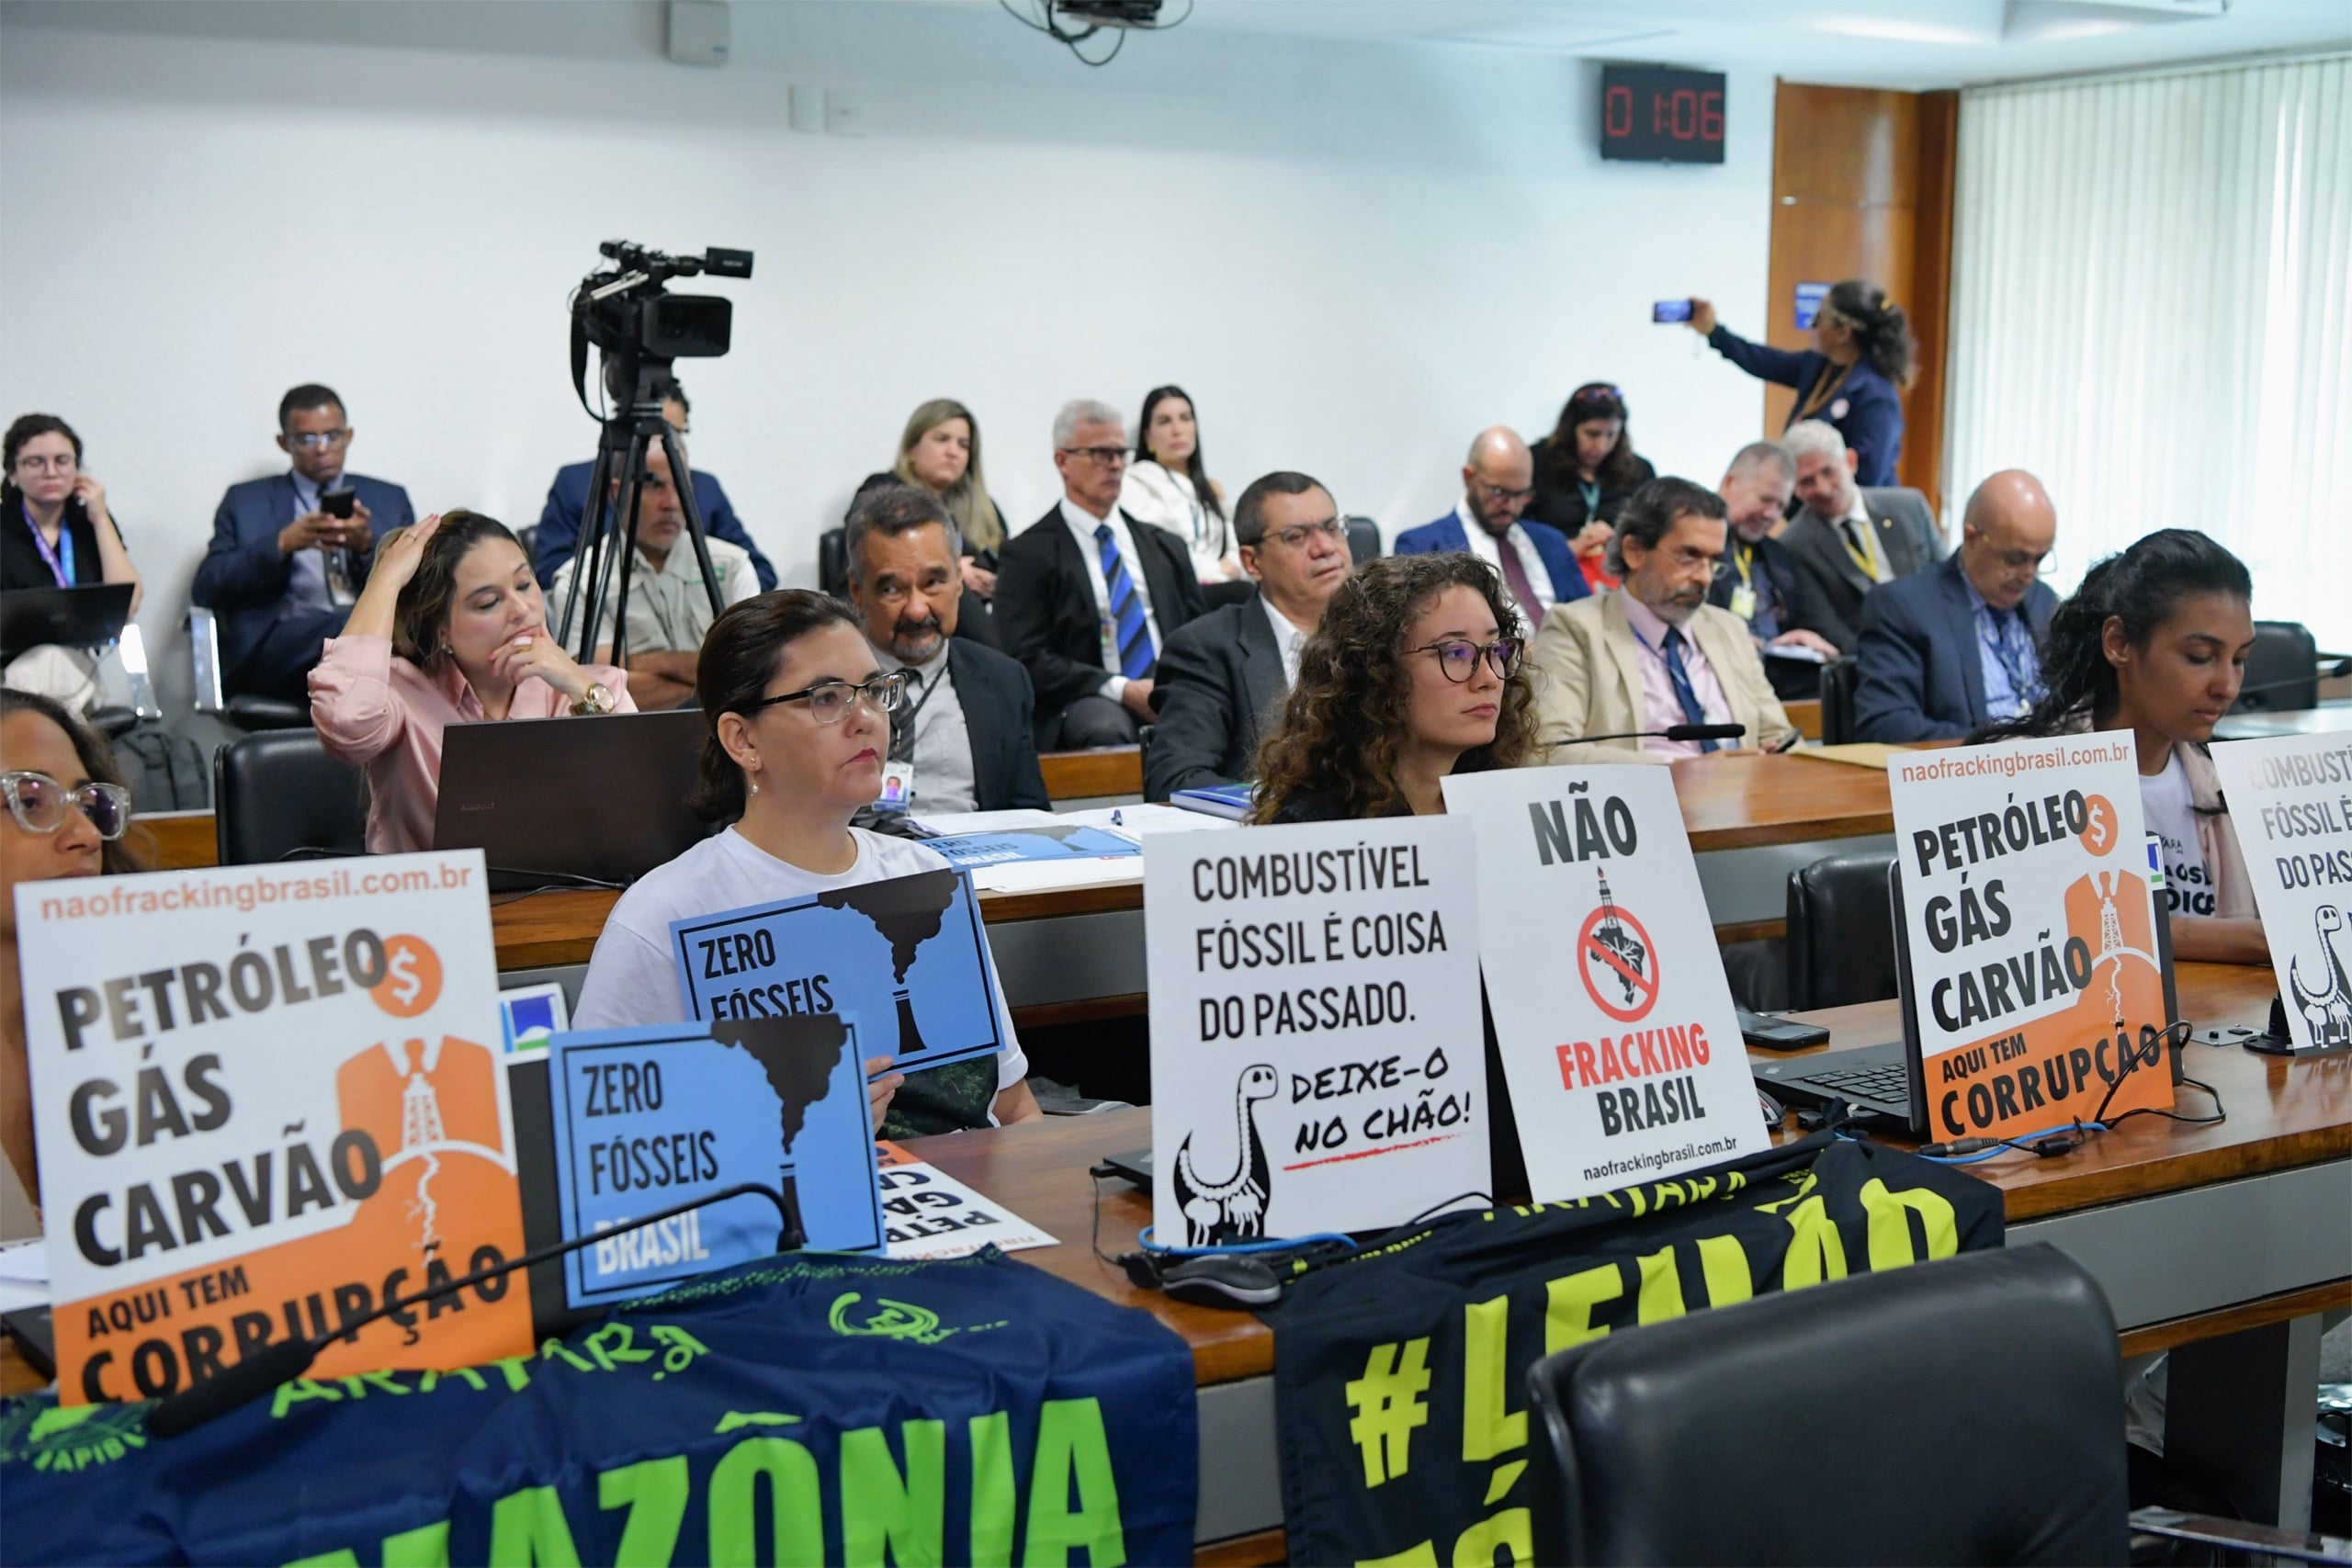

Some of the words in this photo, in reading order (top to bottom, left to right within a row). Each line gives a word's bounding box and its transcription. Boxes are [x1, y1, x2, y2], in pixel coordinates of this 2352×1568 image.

[1902, 743, 2129, 782] naofrackingbrasil.com.br
[1528, 782, 1638, 866] NÃO
[1913, 789, 2087, 877] PETRÓLEO
[2261, 801, 2343, 840] FÓSSIL
[41, 863, 471, 921] naofrackingbrasil.com.br
[1193, 841, 1430, 902] COMBUSTÍVEL
[2276, 854, 2311, 890] DO
[2311, 850, 2352, 886] PAS
[1196, 919, 1316, 972] FÓSSIL
[1326, 912, 1341, 961] É
[1351, 910, 1447, 959] COISA
[1924, 872, 2012, 953] GÁS
[698, 929, 775, 979] ZERO
[1931, 929, 2093, 1033] CARVÃO
[54, 928, 388, 1052] PETRÓLEO
[710, 975, 833, 1021] FÓSSEIS
[1200, 993, 1244, 1042] DO
[1255, 981, 1416, 1037] PASSADO.
[1291, 1047, 1450, 1104] DEIXE-O
[1555, 1022, 1711, 1090] FRACKING
[1940, 1018, 2161, 1136] CORRUPÇÃO
[1941, 1046, 1987, 1083] AQUI
[1990, 1033, 2027, 1060] TEM
[69, 1043, 233, 1157] GÁS
[582, 1060, 662, 1119] ZERO
[1598, 1076, 1706, 1138] BRASIL
[1295, 1114, 1346, 1155] NO
[1363, 1091, 1471, 1140] CHÃO!
[589, 1131, 719, 1196] FÓSSEIS
[1583, 1137, 1738, 1182] naofrackingbrasil.com.br
[73, 1119, 382, 1269] CARVÃO
[883, 1191, 963, 1219] GÁ
[594, 1209, 710, 1276] BRASIL
[87, 1288, 172, 1338] AQUI
[179, 1265, 251, 1310] TEM
